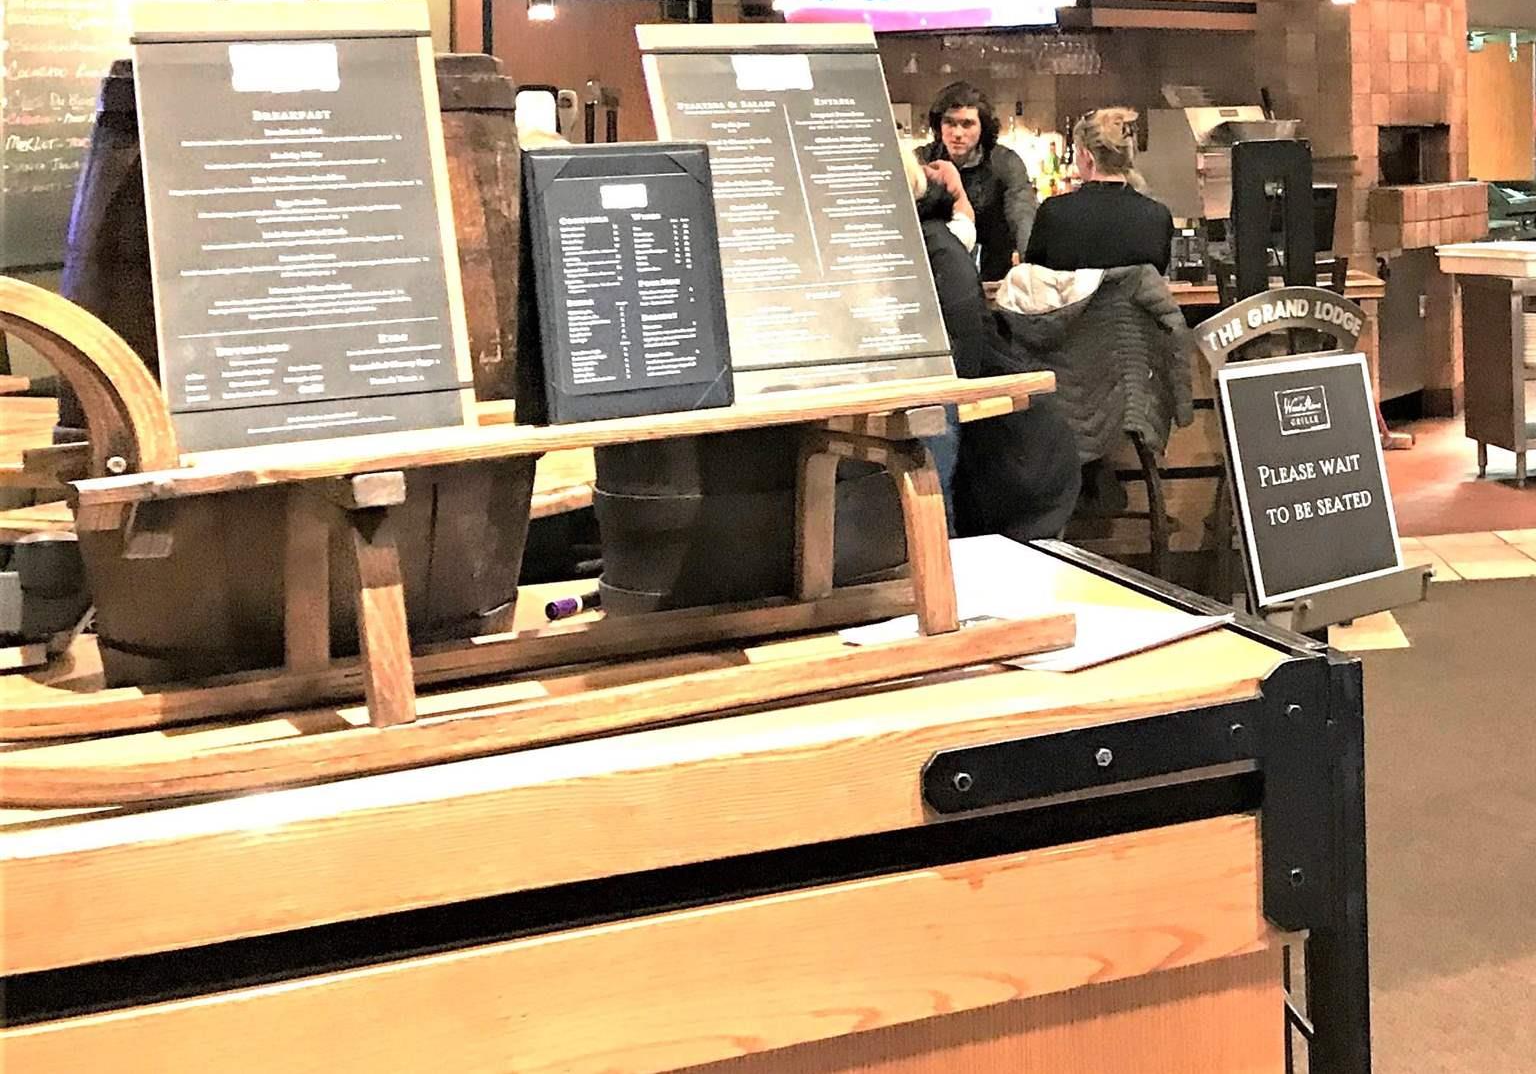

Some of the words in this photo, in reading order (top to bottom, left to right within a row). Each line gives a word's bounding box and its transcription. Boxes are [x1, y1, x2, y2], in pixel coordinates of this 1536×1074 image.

[252, 110, 332, 121] BREAKFAST
[1203, 317, 1243, 351] THE
[1248, 298, 1309, 329] GRAND
[1313, 299, 1362, 337] LODGE
[1257, 461, 1316, 488] PLEASE
[1319, 454, 1360, 475] WAIT
[1266, 505, 1290, 526] TO
[1295, 501, 1313, 520] BE
[1316, 490, 1372, 517] SEATED
